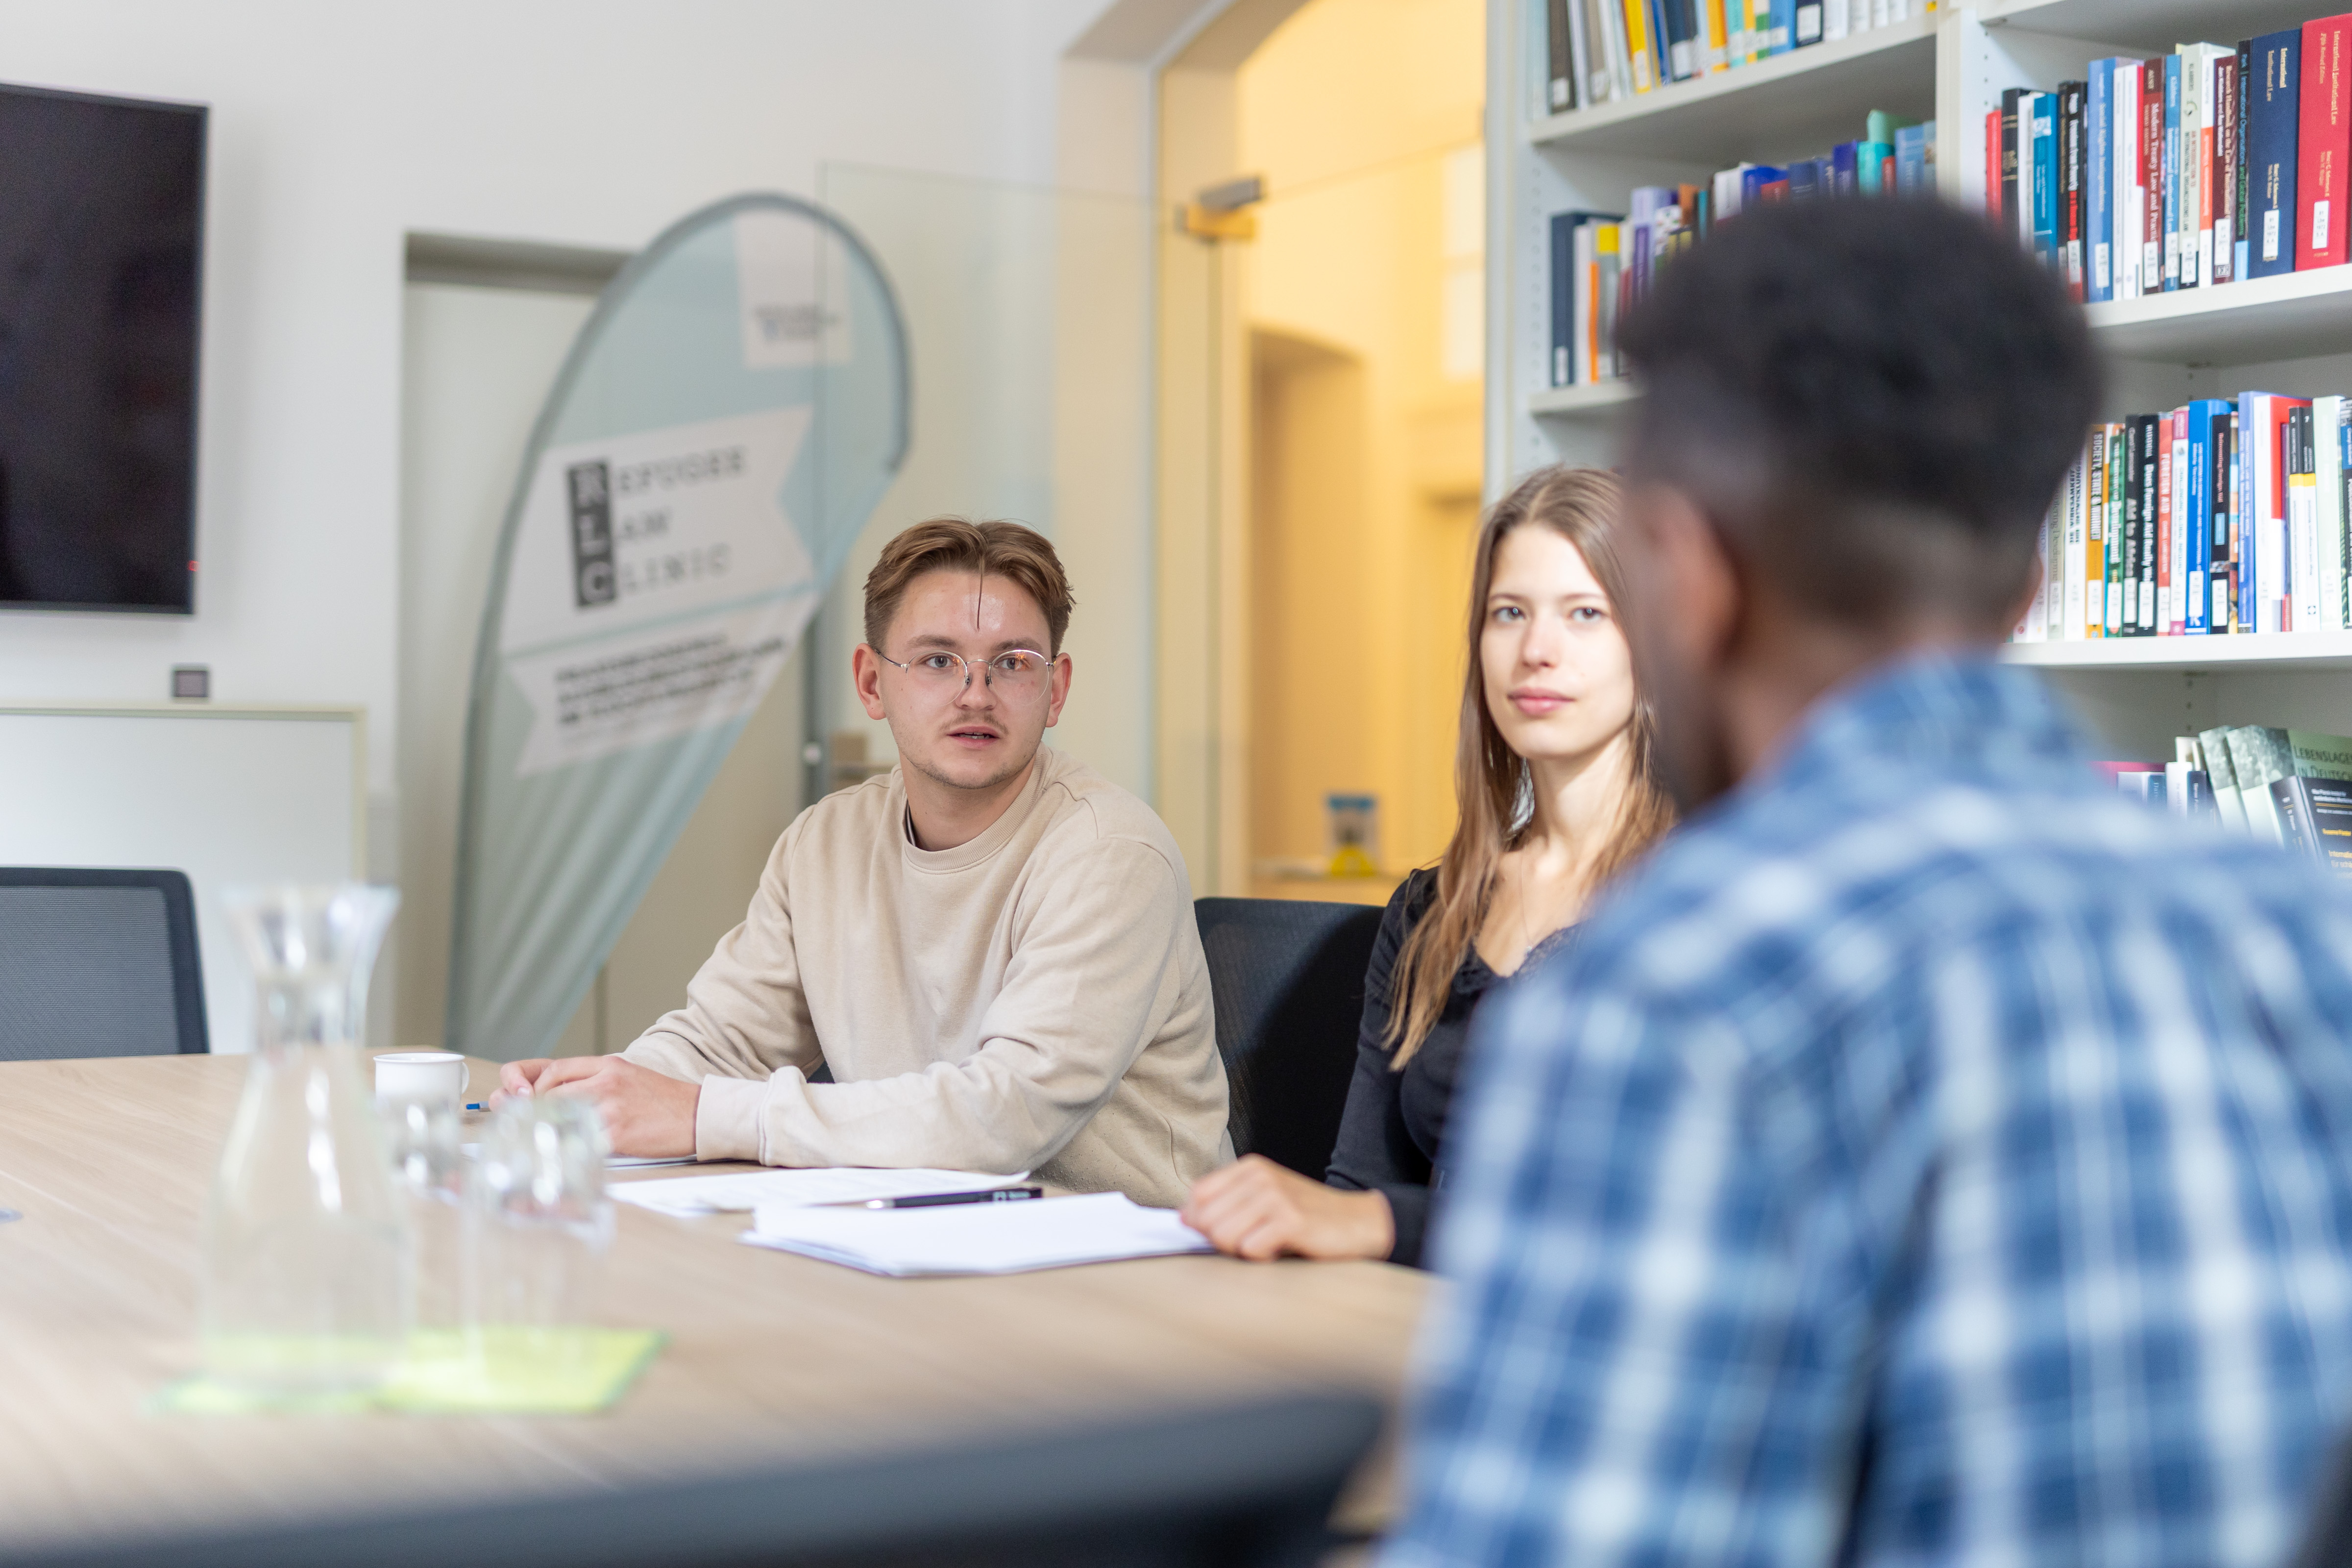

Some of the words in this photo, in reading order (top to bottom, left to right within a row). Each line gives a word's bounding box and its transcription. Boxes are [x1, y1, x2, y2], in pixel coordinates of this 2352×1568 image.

[2332, 30, 2341, 72] International
[2279, 48, 2288, 88] International
[2151, 102, 2160, 139] Modern
[2148, 140, 2159, 170] Treaty
[2150, 172, 2158, 191] Law
[2150, 192, 2158, 210] and
[2091, 433, 2103, 470] SOCIETY,
[569, 445, 749, 509] REFUGEE
[2091, 470, 2103, 496] STATE
[2144, 464, 2154, 488] Does
[2161, 453, 2171, 495] FOREIGN
[2091, 496, 2103, 506] &
[2141, 488, 2154, 521] Foreign
[2161, 496, 2170, 514] AID
[576, 506, 672, 558] LAW
[2143, 521, 2153, 538] Aid
[2051, 530, 2061, 580] Developme
[2141, 539, 2153, 566] Really
[581, 543, 733, 606] CLINIC
[2294, 744, 2352, 764] LEBENSLAGE
